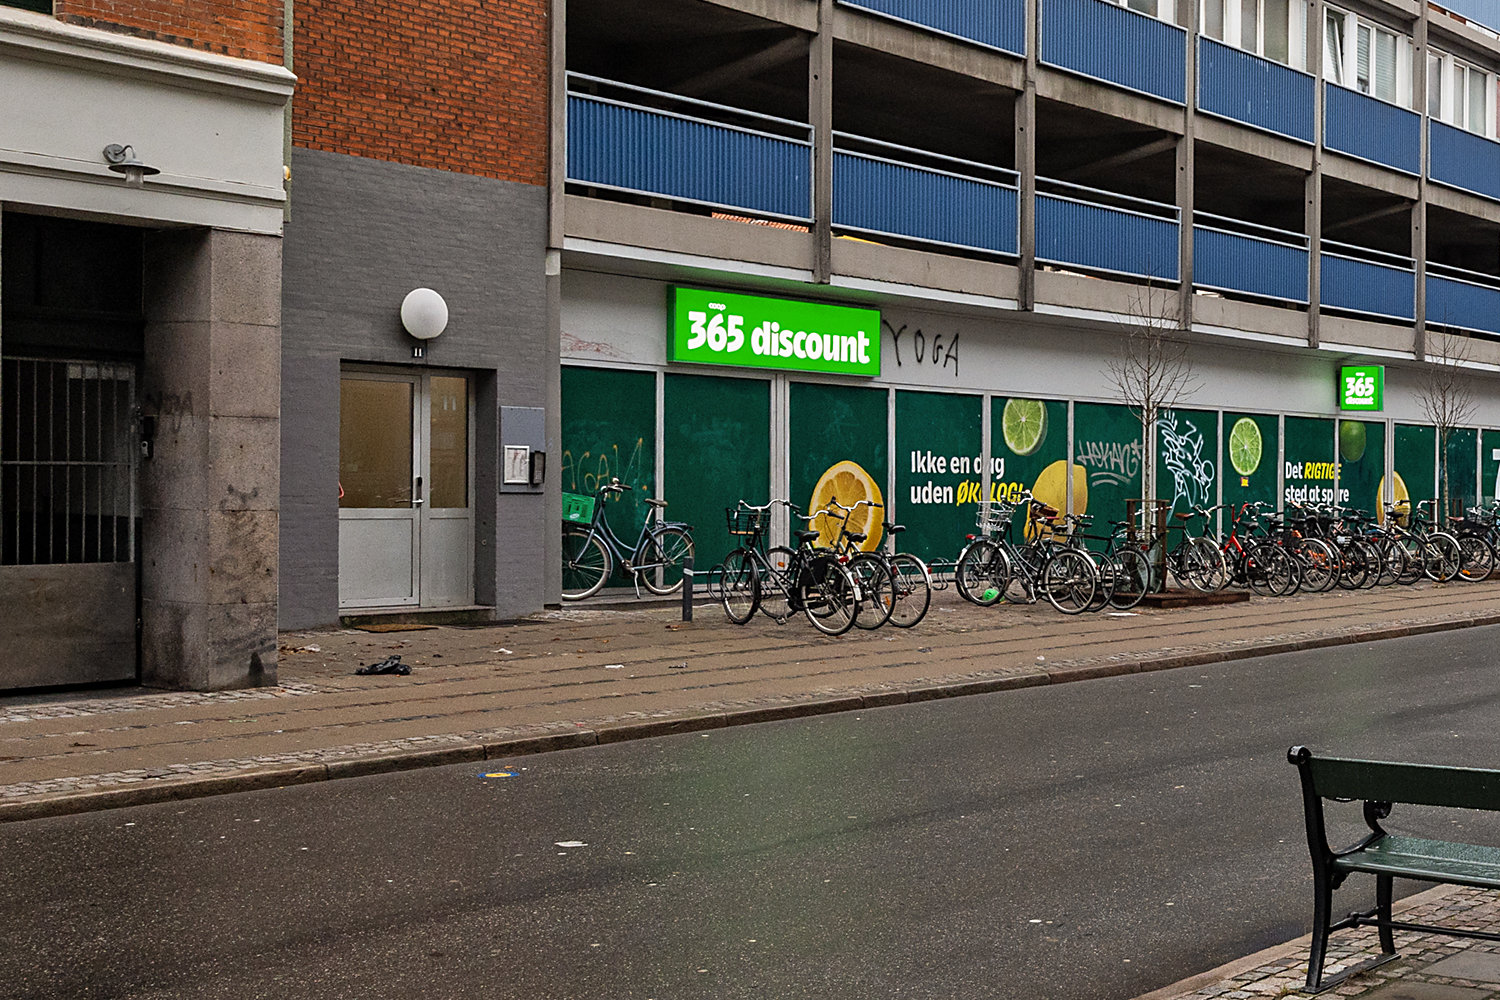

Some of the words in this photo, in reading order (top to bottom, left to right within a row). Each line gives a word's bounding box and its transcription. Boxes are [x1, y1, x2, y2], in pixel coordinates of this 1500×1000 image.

[686, 310, 745, 352] 365
[751, 320, 870, 364] discount
[1345, 377, 1375, 396] 365
[911, 450, 947, 473] Ikke
[950, 456, 970, 473] en
[1285, 461, 1303, 479] Det
[1304, 461, 1342, 479] RIGTIGE
[910, 481, 953, 504] uden
[956, 479, 1024, 506] ØKLOGI
[1284, 484, 1308, 502] sted
[1309, 484, 1320, 502] at
[1321, 487, 1350, 504] spre
